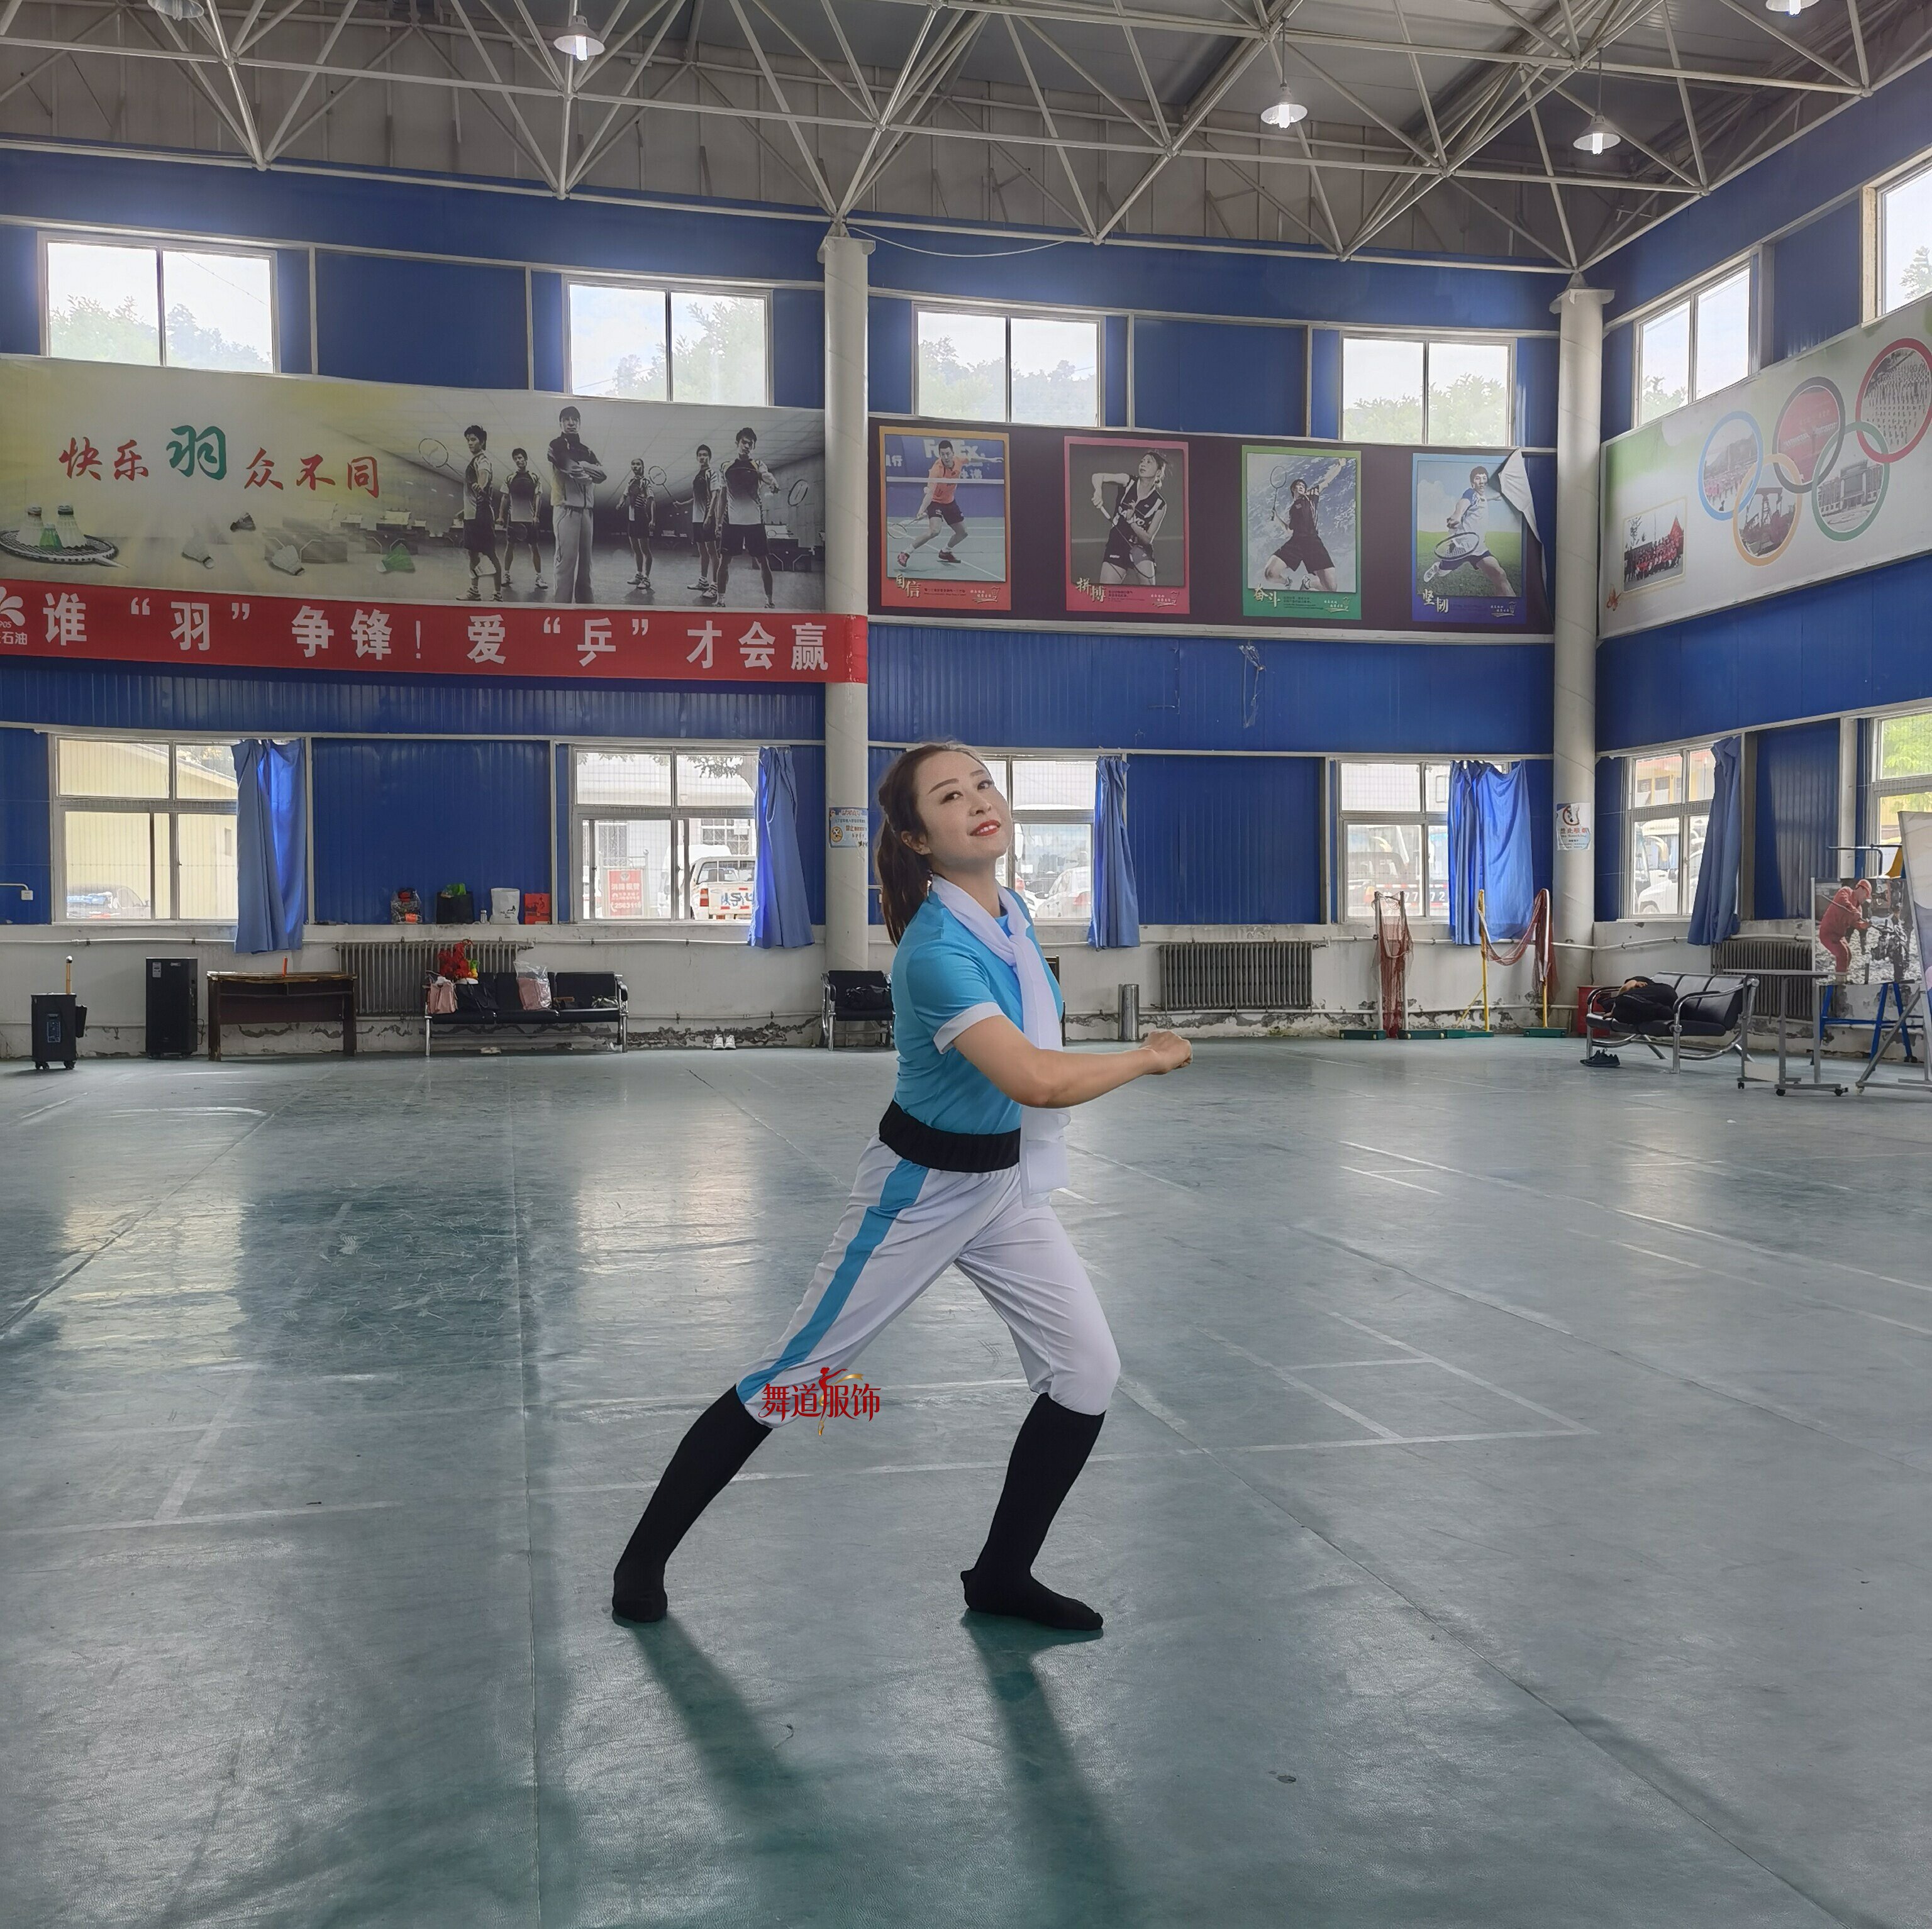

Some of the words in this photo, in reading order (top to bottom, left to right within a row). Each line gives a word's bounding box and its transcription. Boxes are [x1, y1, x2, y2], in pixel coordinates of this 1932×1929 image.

[59, 424, 379, 498] 快乐羽众不同
[896, 573, 921, 598] 自信
[1076, 578, 1106, 602] 拼搏
[1253, 583, 1281, 608] 奋斗
[1423, 589, 1449, 613] 坚韧
[0, 631, 28, 646] 石油
